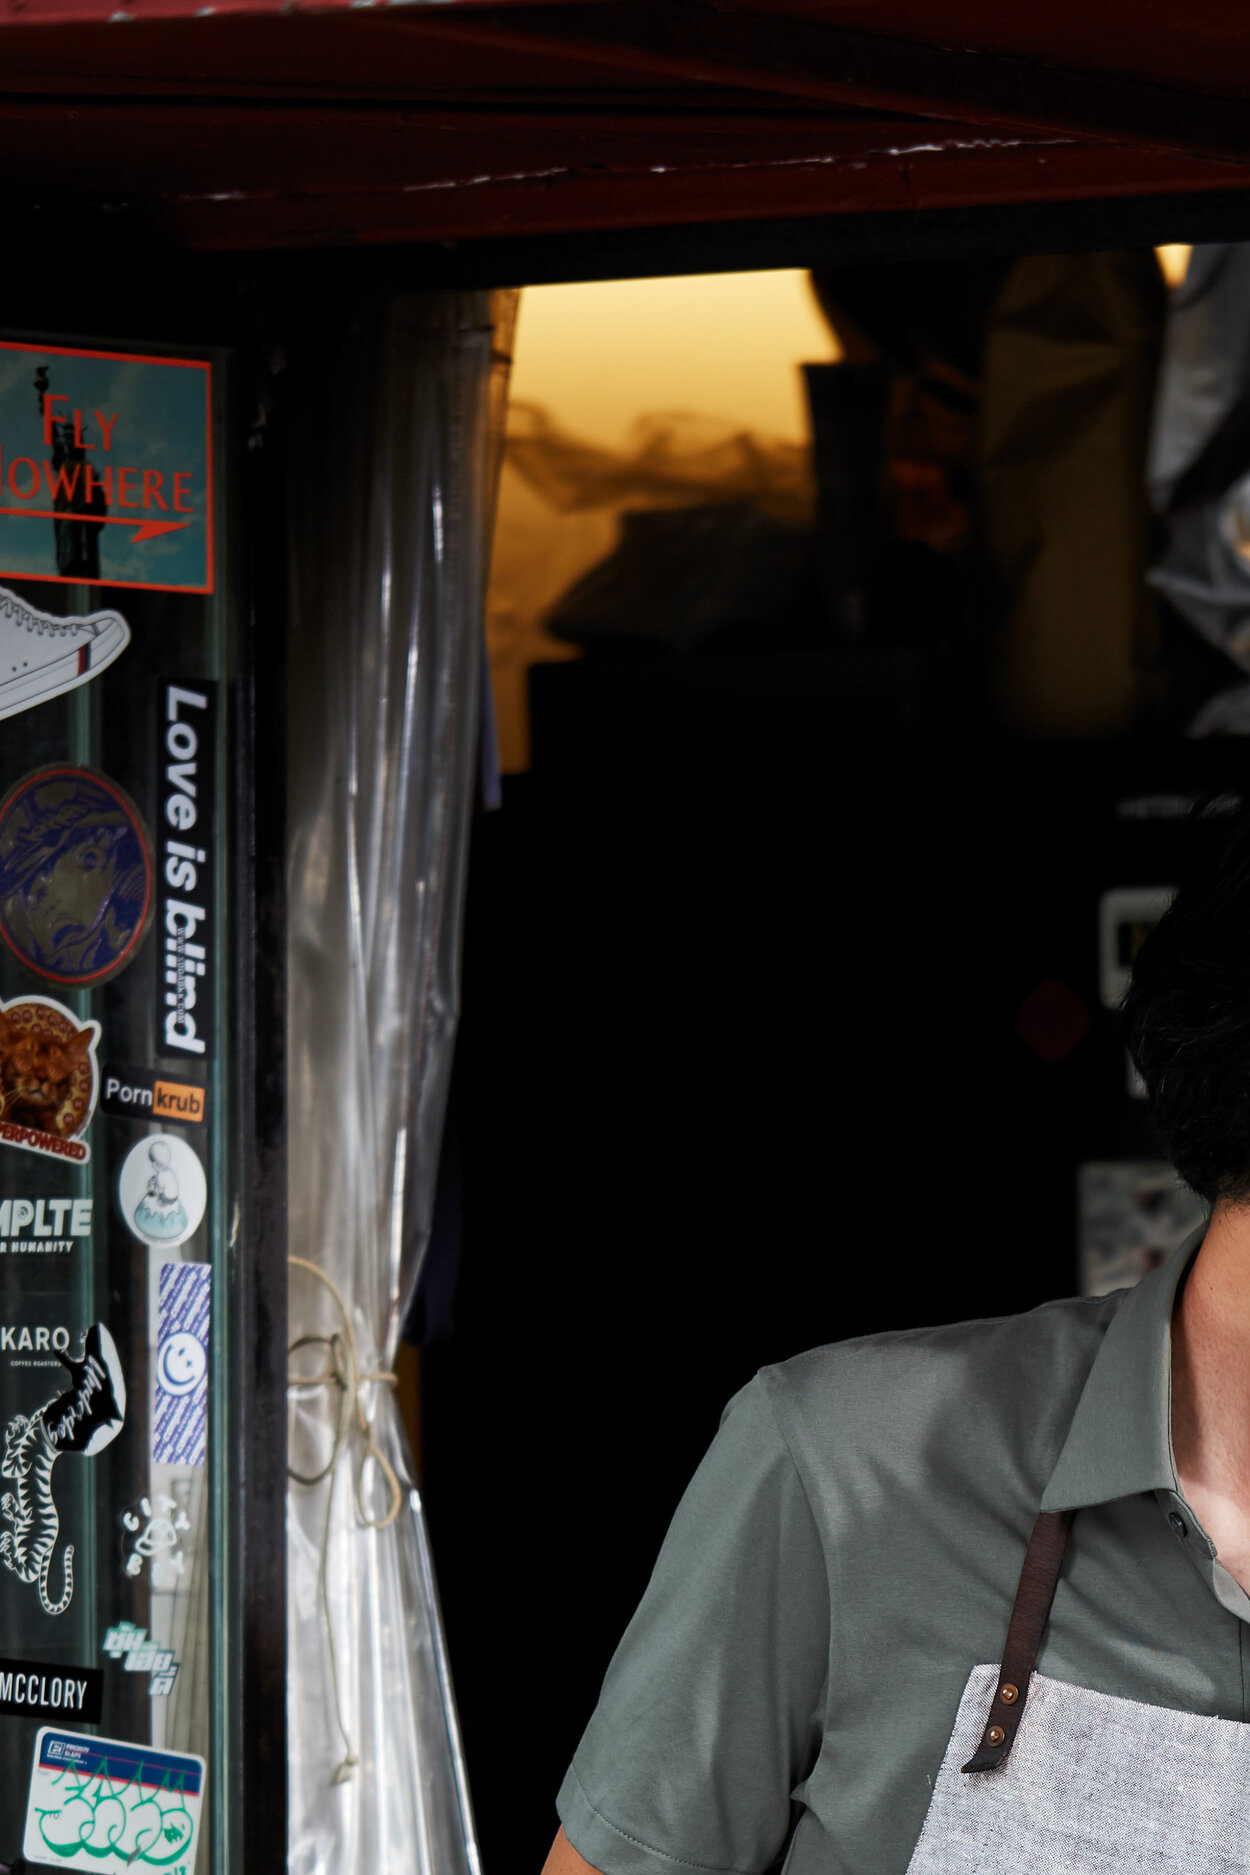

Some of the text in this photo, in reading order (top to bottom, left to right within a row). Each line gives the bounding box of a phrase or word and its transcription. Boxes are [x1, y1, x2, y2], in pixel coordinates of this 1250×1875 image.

[43, 394, 119, 452] FLY
[0, 443, 195, 513] OWHERE
[164, 685, 208, 1054] Love is blind
[0, 1121, 87, 1161] ERPOWERED
[11, 1240, 74, 1253] HUMANITY
[0, 1326, 70, 1351] KARO
[10, 1359, 32, 1367] COFFEE
[0, 1671, 88, 1710] MCCLORY
